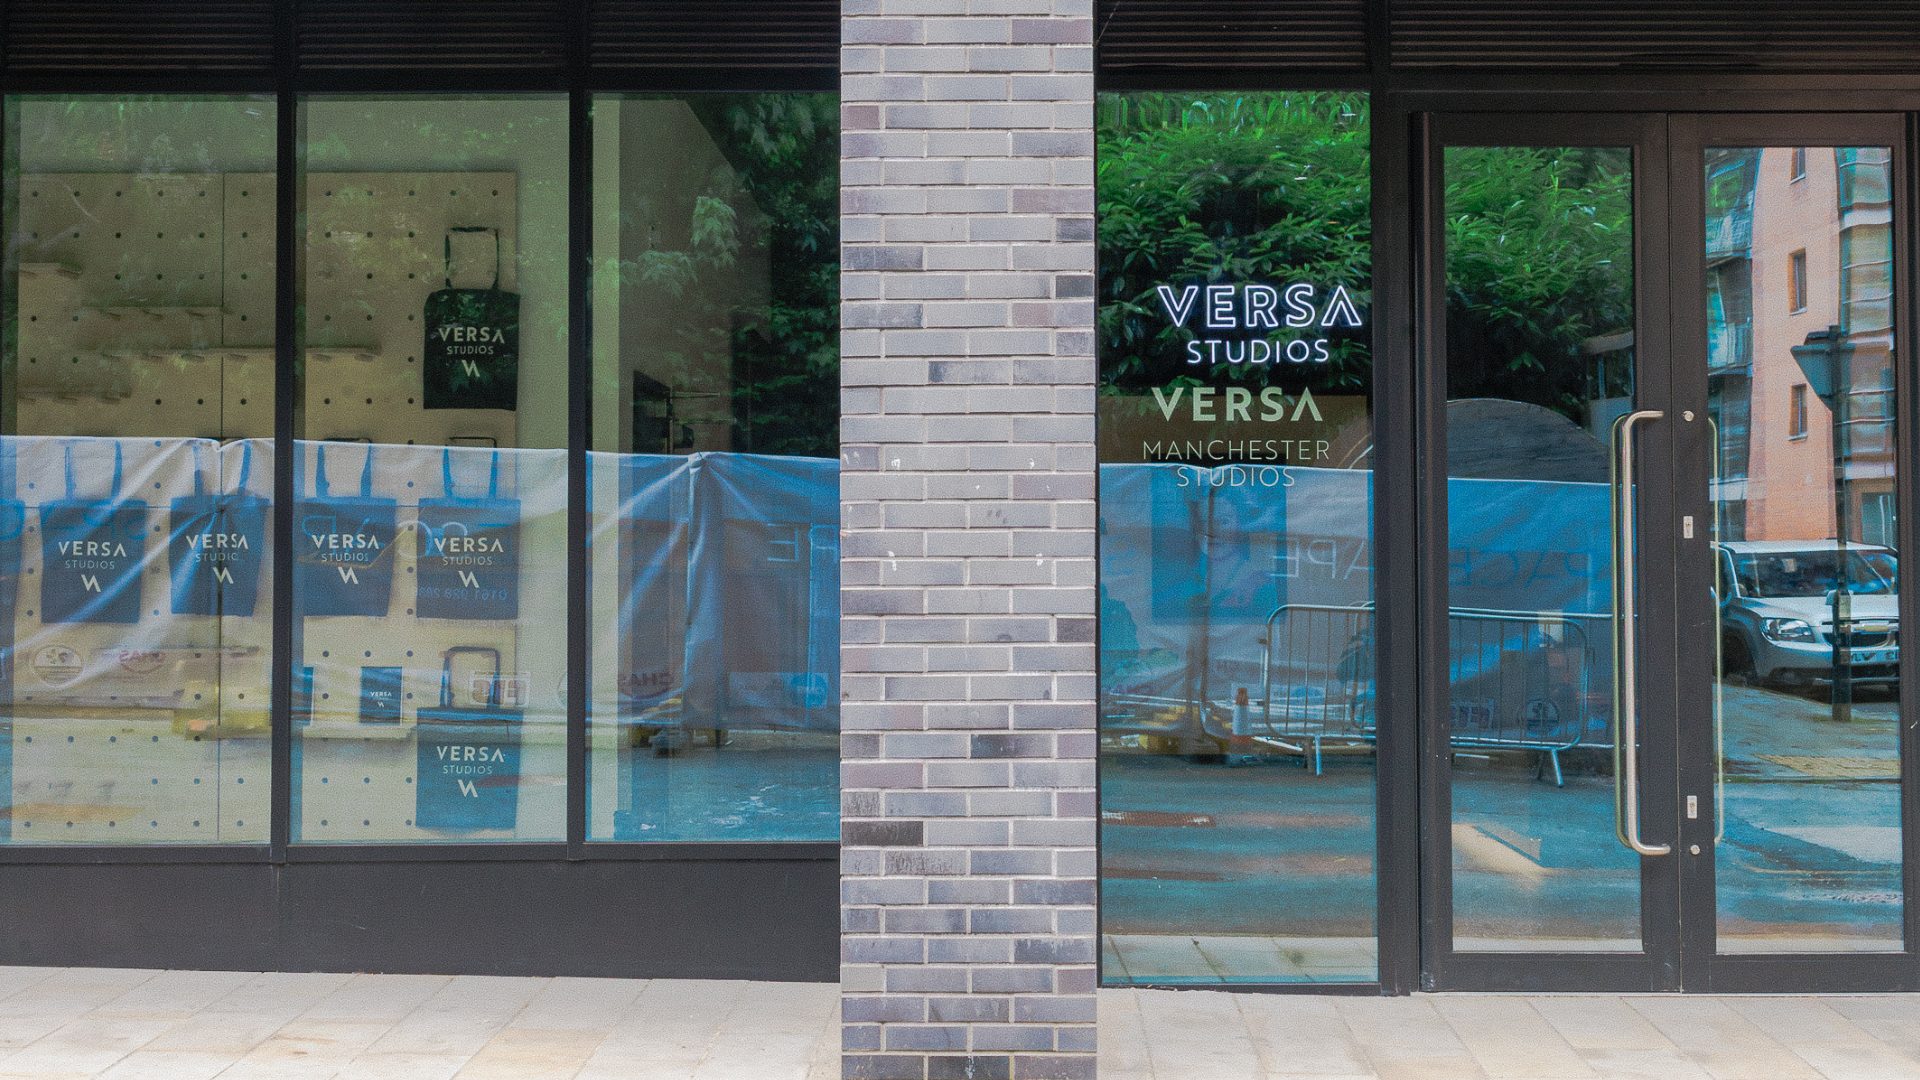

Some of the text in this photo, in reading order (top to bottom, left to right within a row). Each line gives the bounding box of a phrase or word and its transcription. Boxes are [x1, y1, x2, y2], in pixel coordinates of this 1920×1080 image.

[1157, 284, 1362, 327] VERSA
[438, 327, 505, 344] VERSA
[446, 345, 494, 355] STUDIOS
[1187, 339, 1329, 364] STUDIOS
[1151, 386, 1323, 422] VERSA
[1143, 440, 1330, 461] MANCHESTER
[1176, 466, 1295, 487] STUDIOS
[58, 541, 127, 557] VERSA
[186, 533, 249, 549] VERSA
[312, 534, 380, 549] VERSA
[434, 537, 504, 552] VERSA
[65, 560, 115, 570] STUDIOS
[321, 553, 369, 562] STUDIOS
[443, 556, 493, 566] STUDIOS
[437, 746, 505, 762] VERSA
[443, 765, 493, 775] STUDIOS
